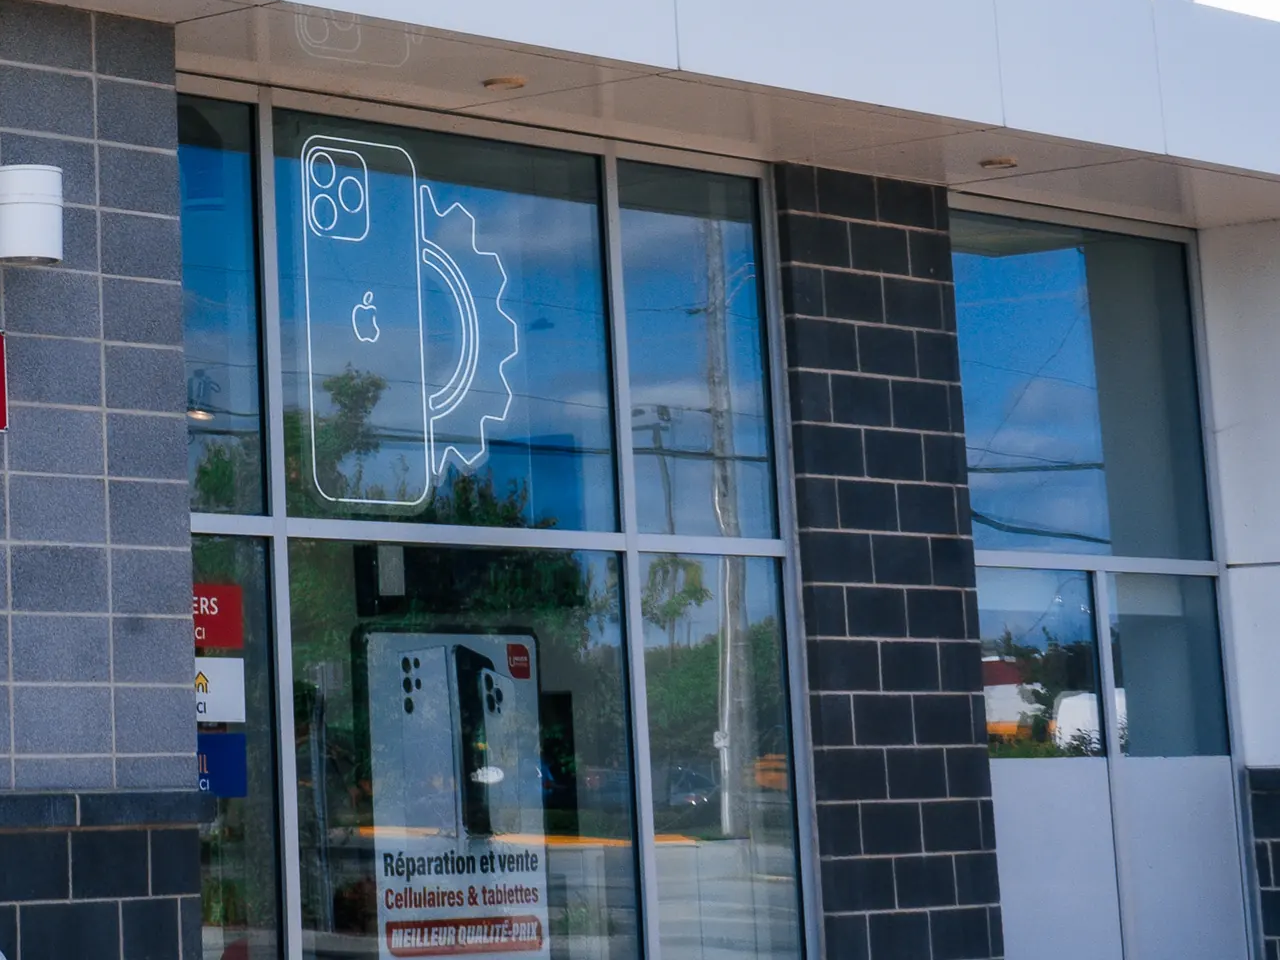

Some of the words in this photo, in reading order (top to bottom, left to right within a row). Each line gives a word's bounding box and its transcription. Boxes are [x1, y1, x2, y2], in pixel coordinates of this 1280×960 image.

[383, 849, 476, 882] Réparation
[479, 850, 496, 874] et
[498, 849, 539, 873] vente
[384, 886, 464, 910] Cellulaires
[467, 885, 479, 907] &
[482, 884, 539, 906] tablettes
[391, 925, 457, 949] MEILLEUR
[458, 919, 539, 947] QUALITÉ-PRIX
